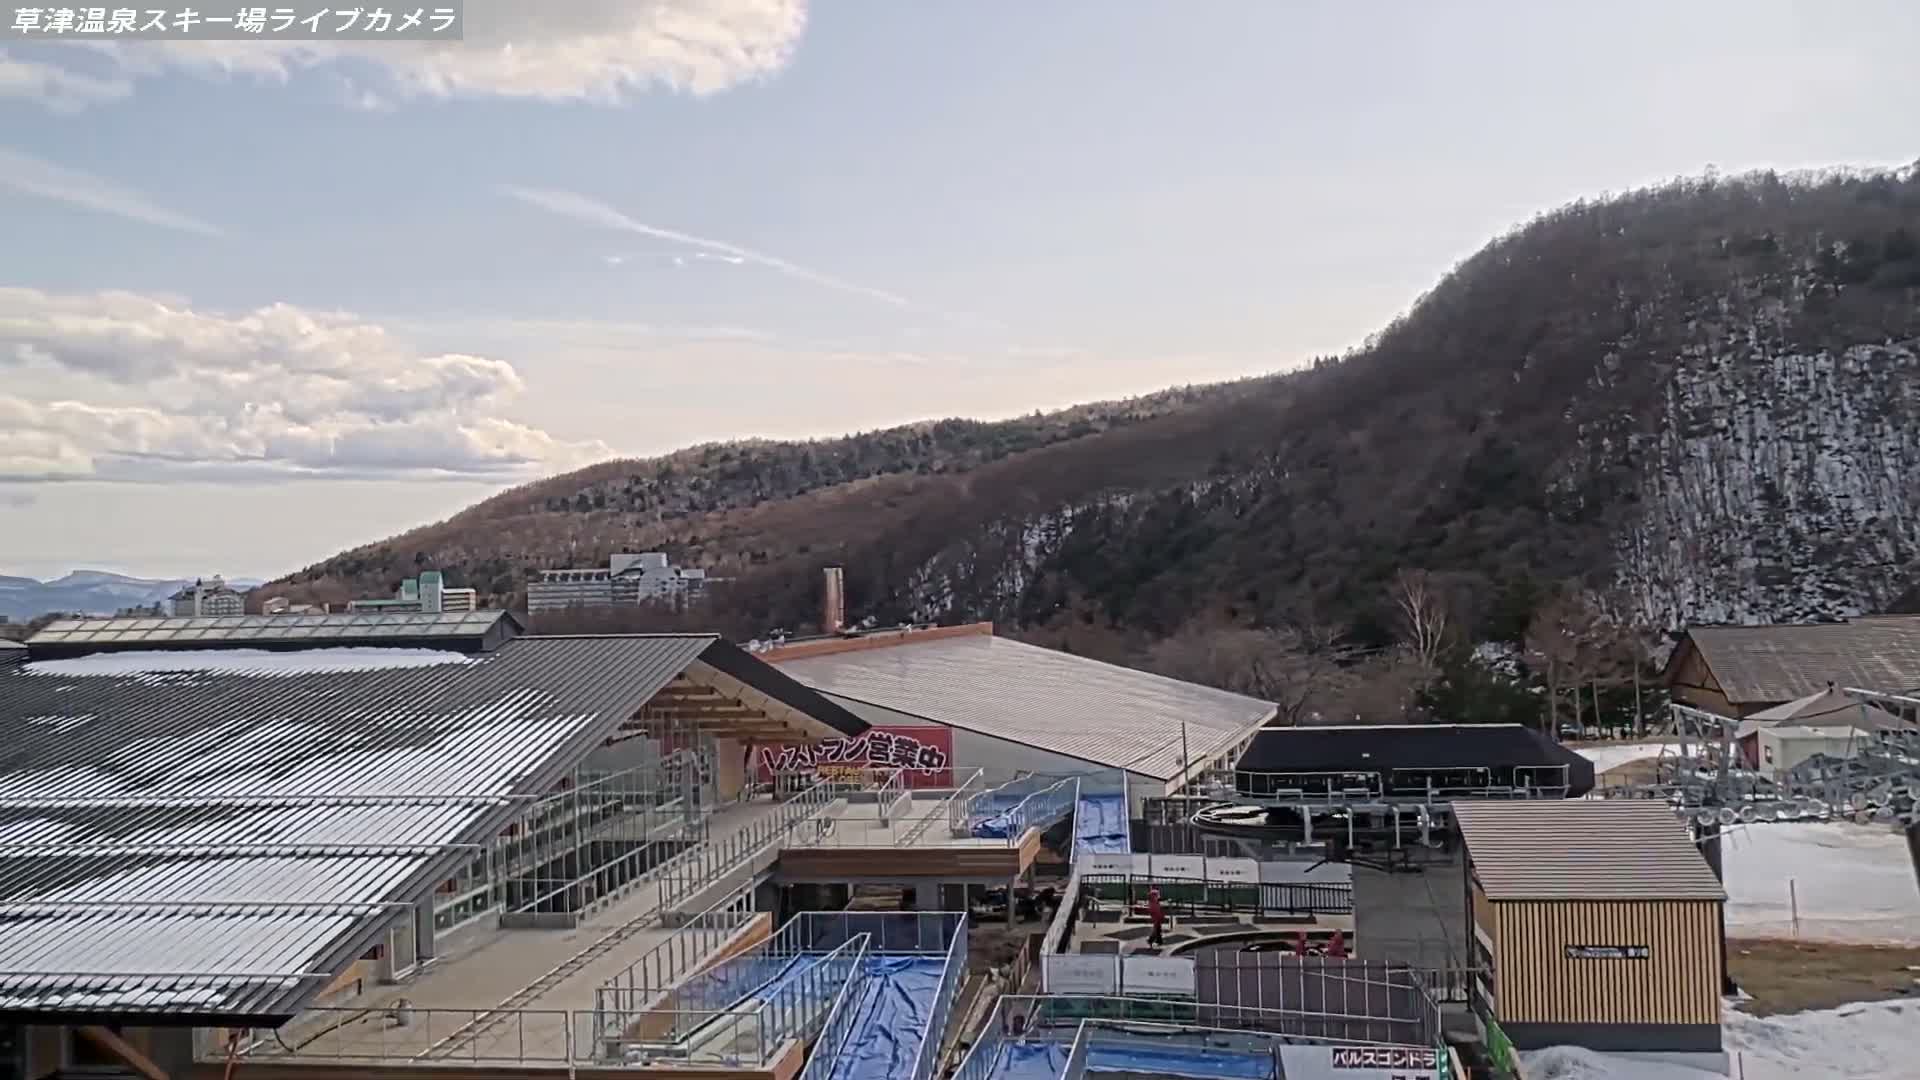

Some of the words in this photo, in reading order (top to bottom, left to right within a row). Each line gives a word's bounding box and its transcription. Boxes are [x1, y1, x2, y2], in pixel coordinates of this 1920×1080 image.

[761, 731, 946, 776] レストラン営業中
